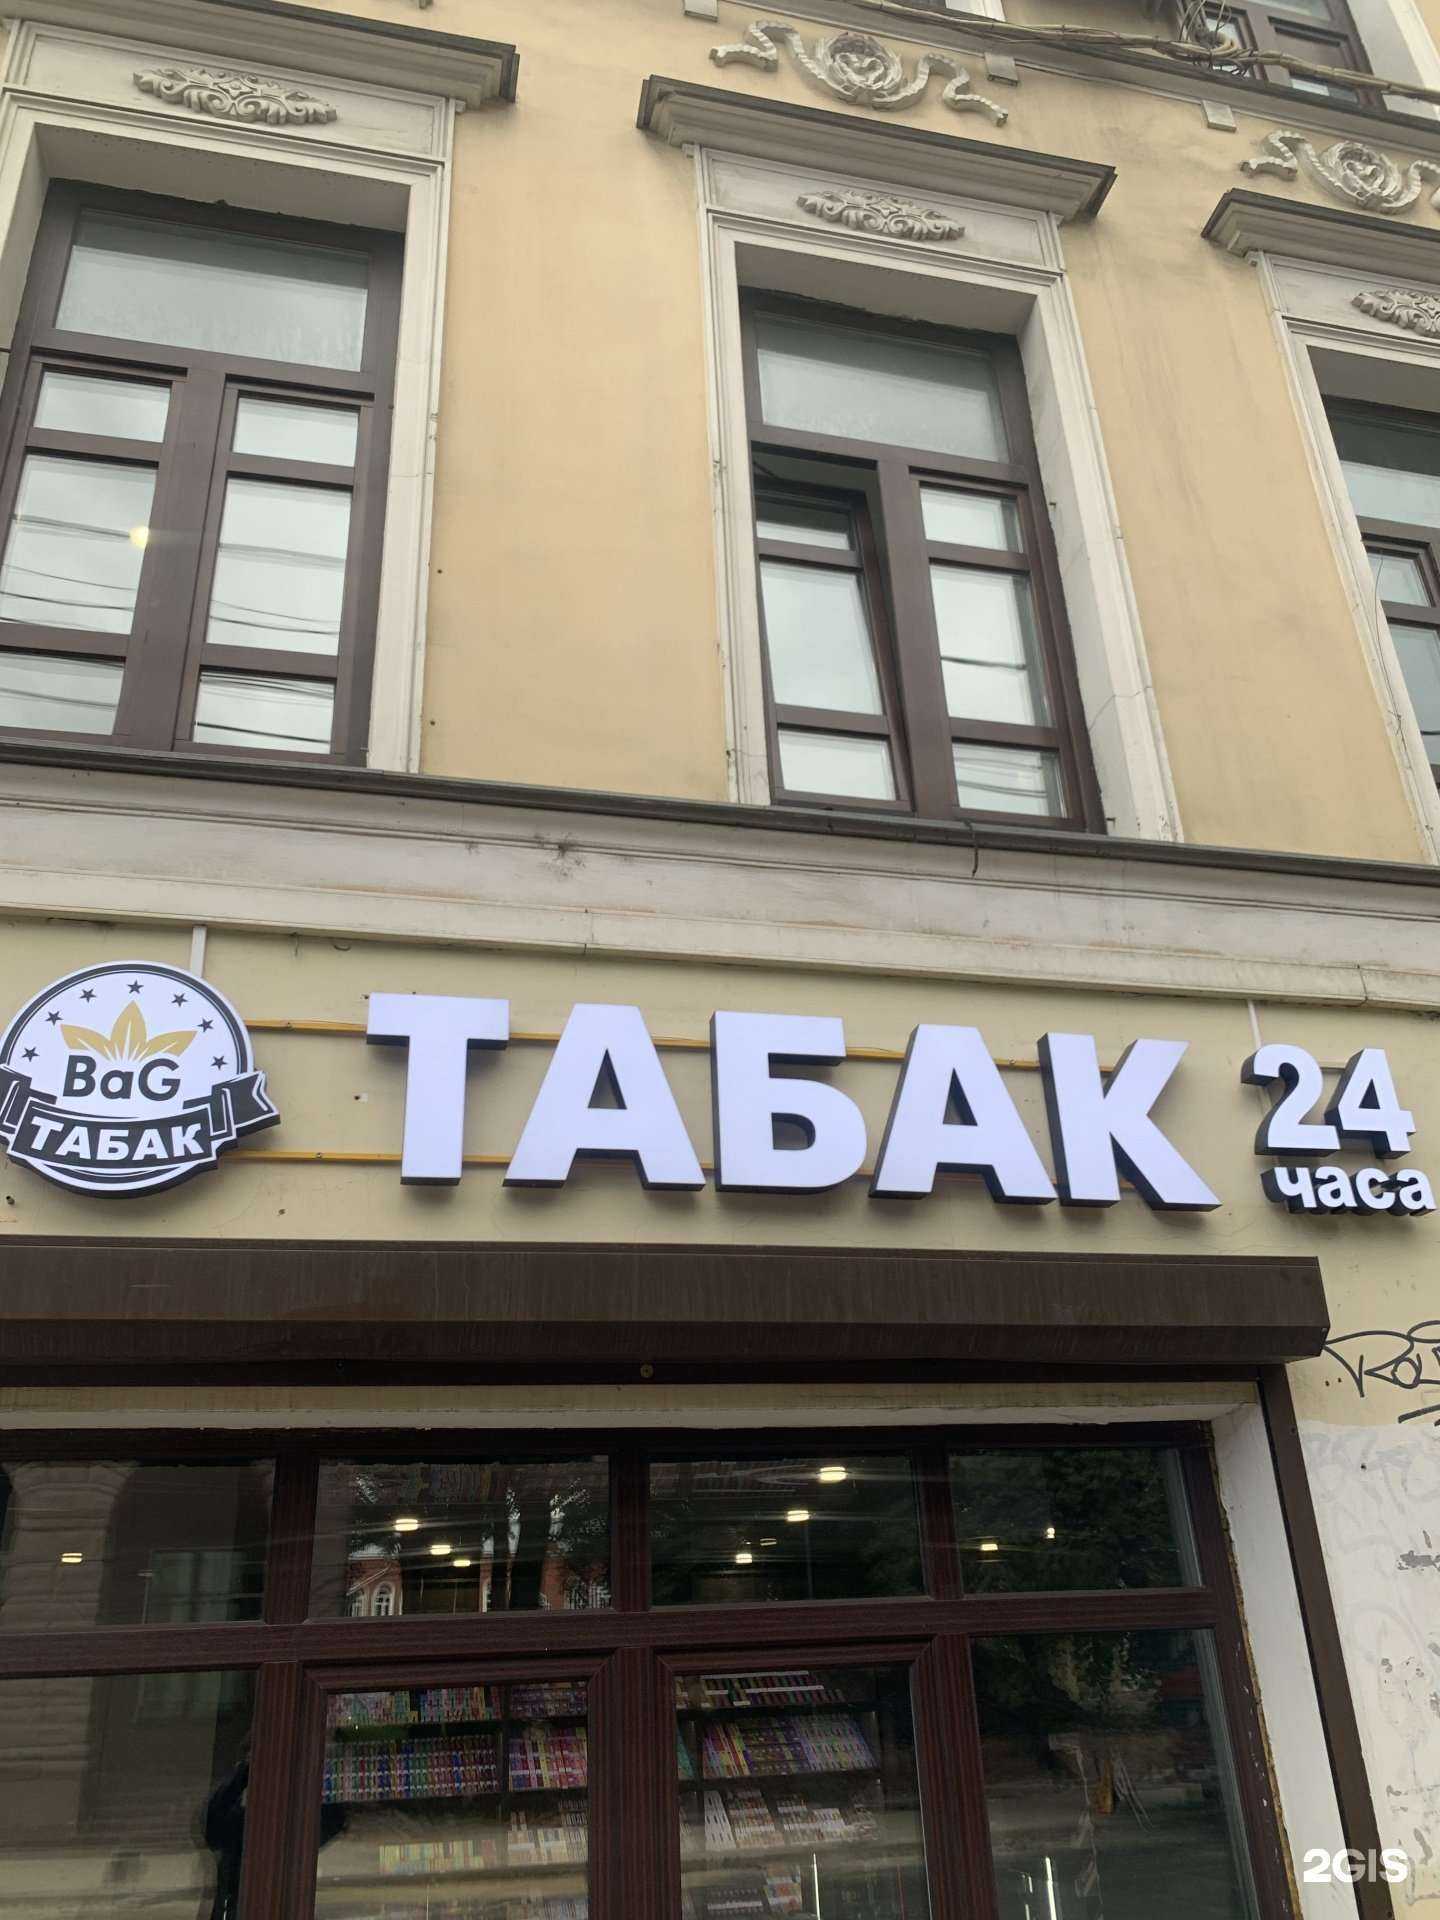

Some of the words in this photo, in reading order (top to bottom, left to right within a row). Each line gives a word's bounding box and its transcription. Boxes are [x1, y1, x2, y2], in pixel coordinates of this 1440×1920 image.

[62, 1054, 181, 1101] BaG
[1248, 1043, 1417, 1155] 24
[366, 992, 1222, 1212] ТАБАК
[30, 1117, 204, 1161] ТАБАК
[1270, 1165, 1437, 1210] часа
